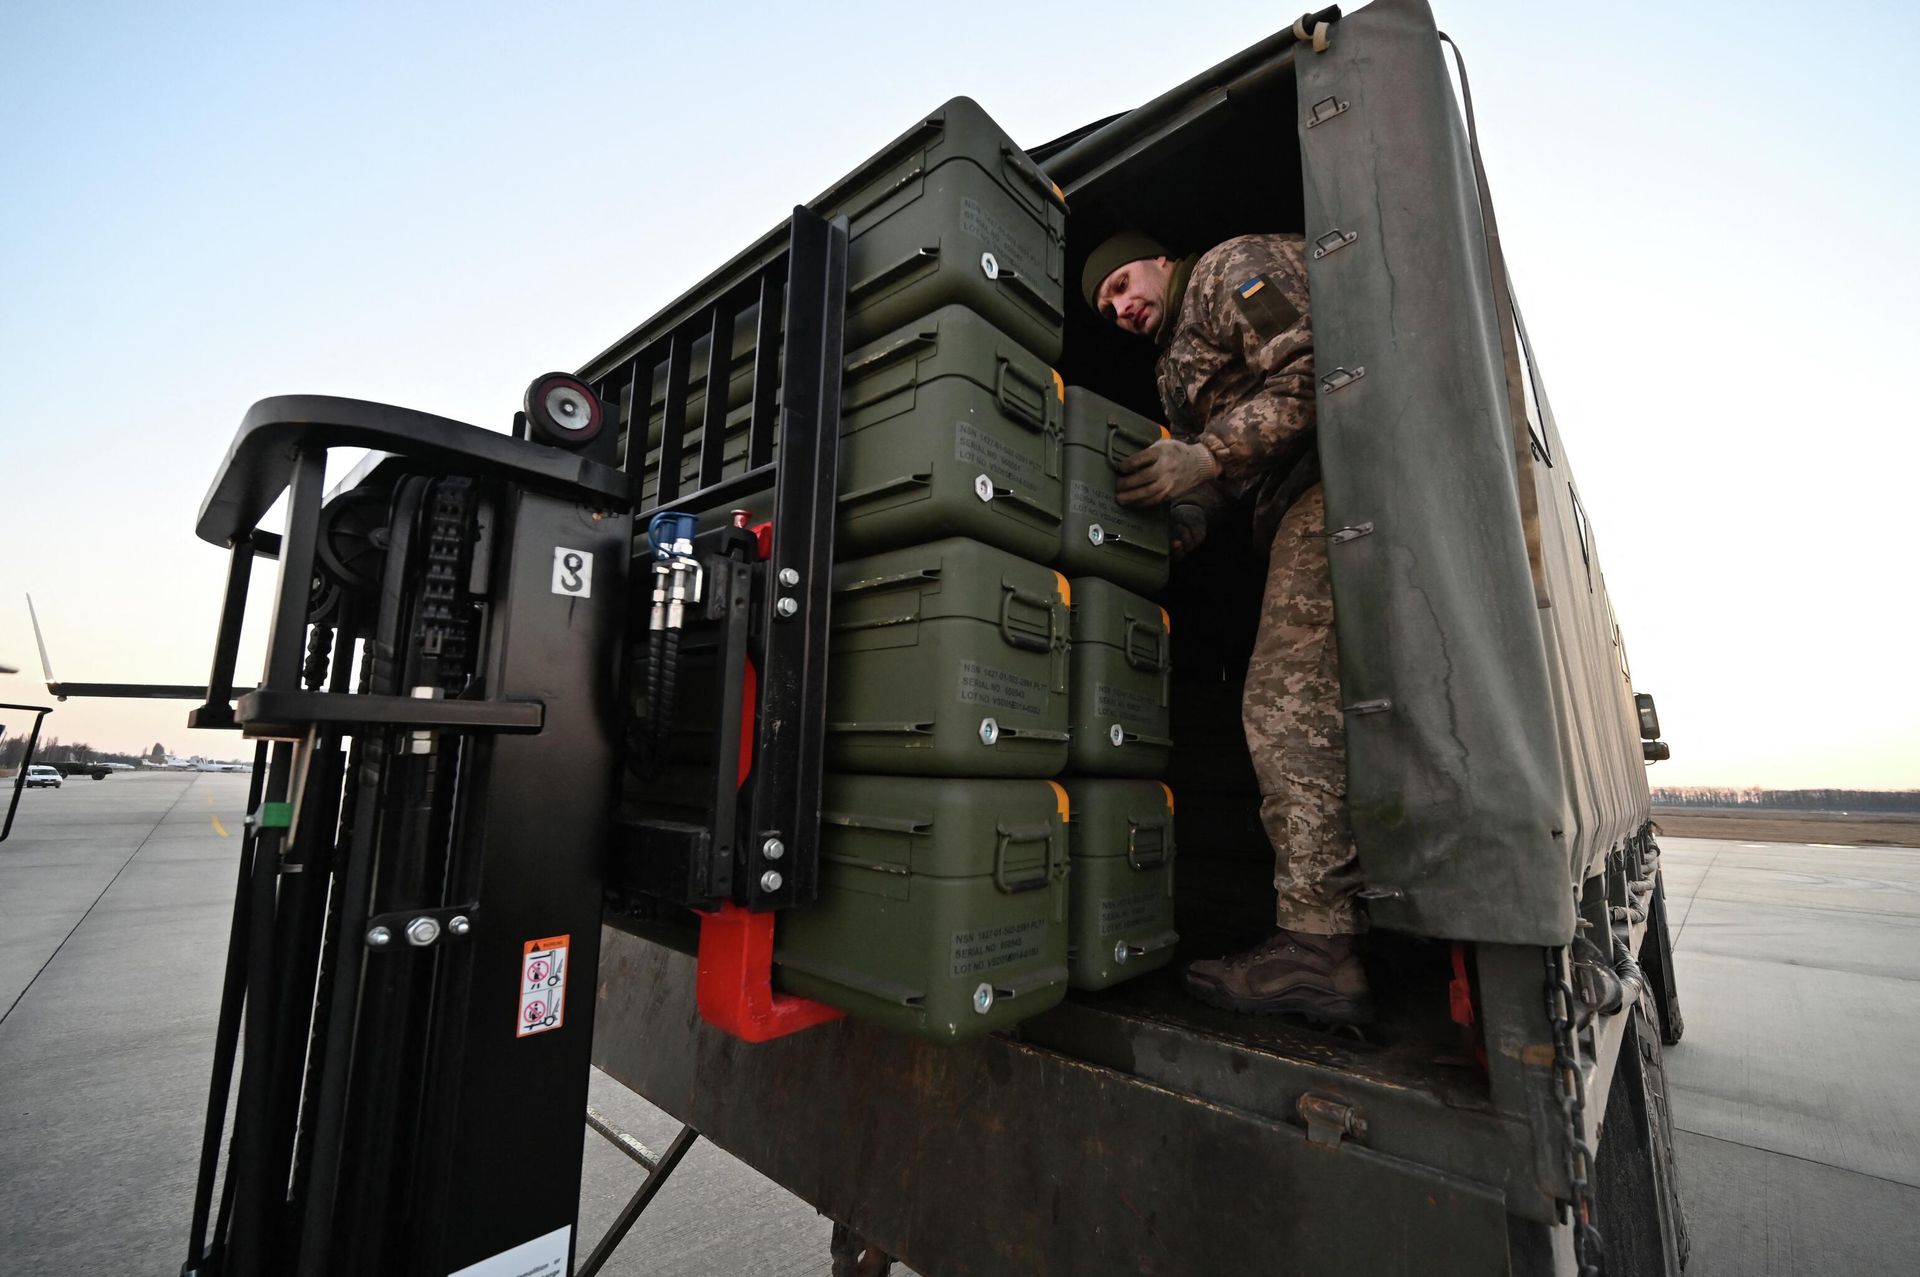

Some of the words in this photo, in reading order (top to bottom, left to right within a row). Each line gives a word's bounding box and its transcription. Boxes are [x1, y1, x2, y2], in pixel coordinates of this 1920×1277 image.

[963, 663, 981, 674] NSN
[961, 677, 989, 690] SERIAL
[960, 689, 978, 701] LOT
[955, 934, 975, 945] NSN
[955, 947, 983, 960] SERIAL
[953, 964, 971, 975] LOT
